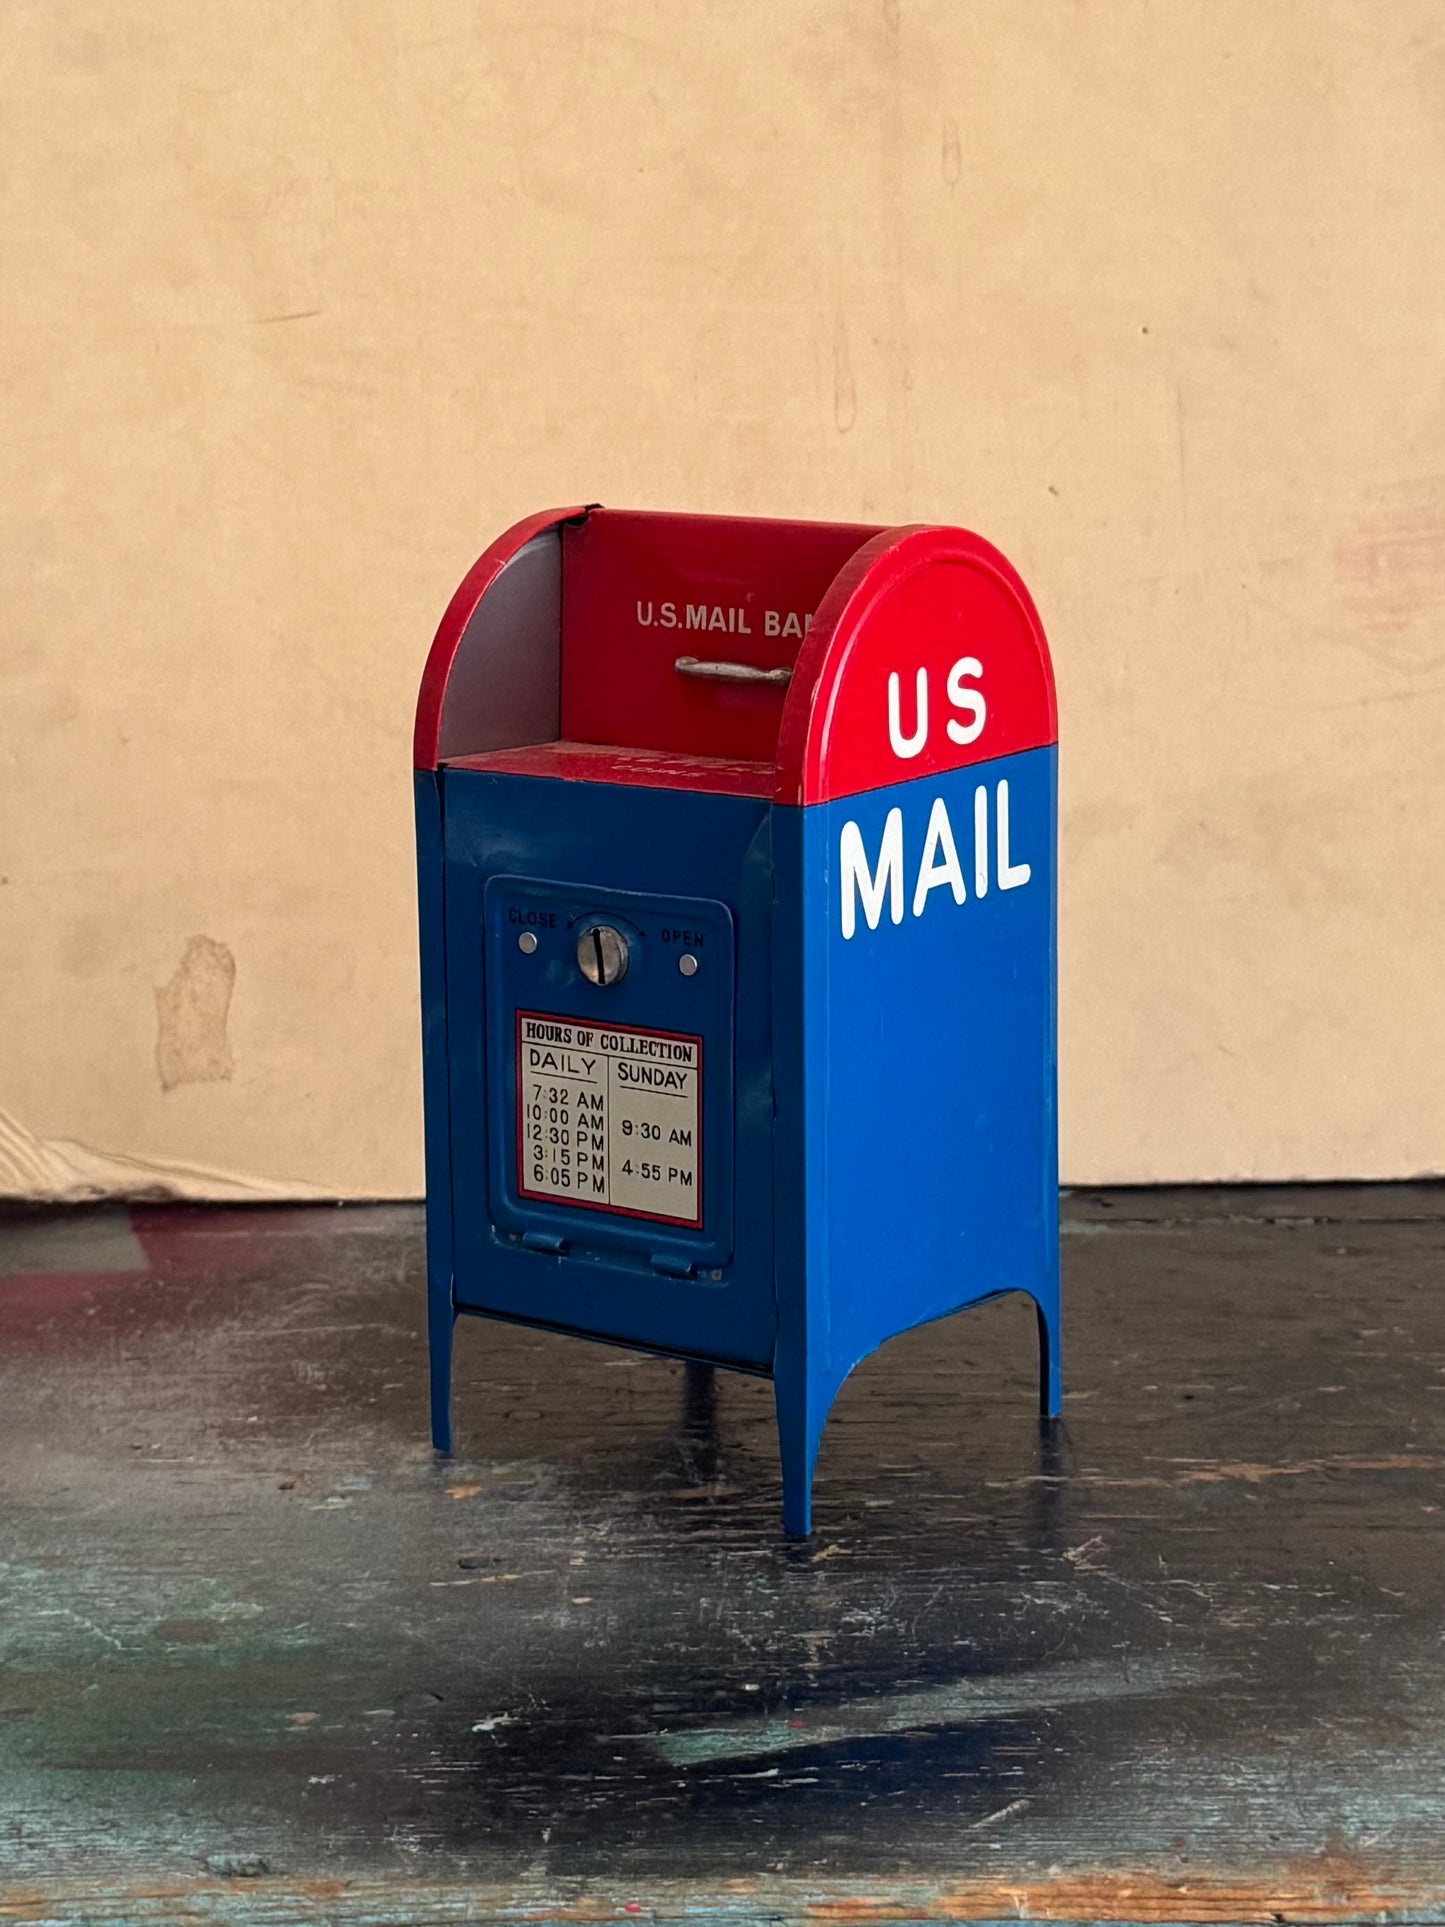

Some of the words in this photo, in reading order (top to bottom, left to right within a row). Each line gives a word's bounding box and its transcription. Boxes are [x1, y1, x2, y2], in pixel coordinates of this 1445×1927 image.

[888, 656, 987, 759] US
[840, 779, 1031, 940] MAIL
[508, 907, 557, 928] CLOSE
[661, 929, 704, 947] OPEN
[526, 1022, 572, 1044] HOURS
[577, 1030, 593, 1047] OF
[600, 1034, 693, 1062] COLLECTION
[530, 1048, 596, 1075] DAILY
[617, 1062, 688, 1090] SUNDAY
[532, 1084, 569, 1105] 7:32
[577, 1091, 604, 1111] AM
[527, 1104, 569, 1125] 10:00
[577, 1113, 604, 1131] AM
[527, 1123, 570, 1145] 12:30
[576, 1131, 604, 1152] PM
[621, 1120, 661, 1141] 9:30
[668, 1128, 692, 1147] AM
[533, 1144, 571, 1165] 3:15
[577, 1152, 604, 1172] PM
[533, 1164, 571, 1187] 6:05
[577, 1172, 605, 1194] PM
[621, 1159, 661, 1181] 4:55
[668, 1167, 693, 1187] PM
